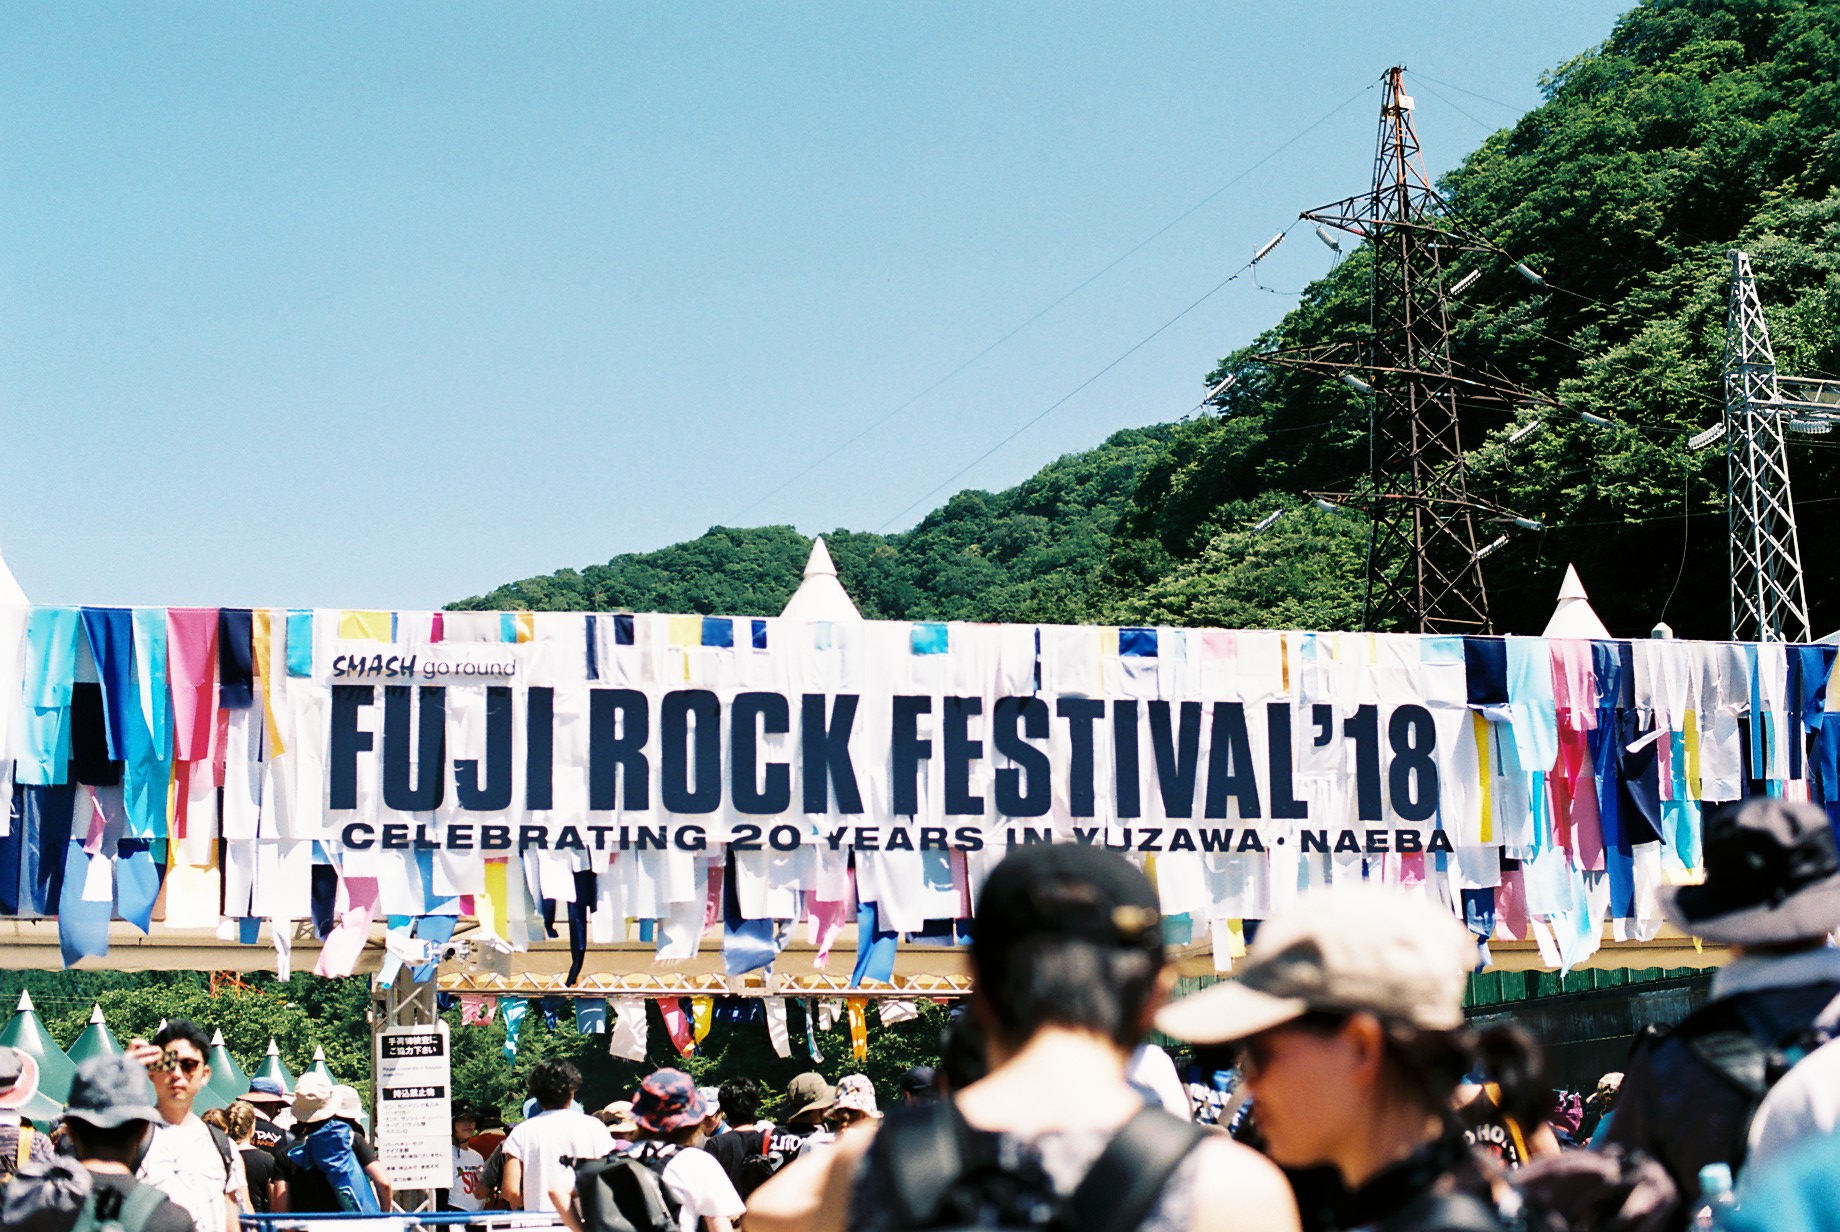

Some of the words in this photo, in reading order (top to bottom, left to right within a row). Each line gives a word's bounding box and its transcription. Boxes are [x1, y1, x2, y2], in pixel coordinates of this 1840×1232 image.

[332, 654, 417, 679] SMASH
[423, 662, 450, 680] go
[455, 659, 516, 678] round
[330, 684, 554, 812] FUJI
[590, 688, 864, 815] ROCK
[342, 822, 707, 852] CELEBRATING
[725, 824, 802, 852] 20
[826, 825, 984, 853] YEARS
[1007, 827, 1052, 846] IN
[1300, 828, 1454, 854] NAEBA
